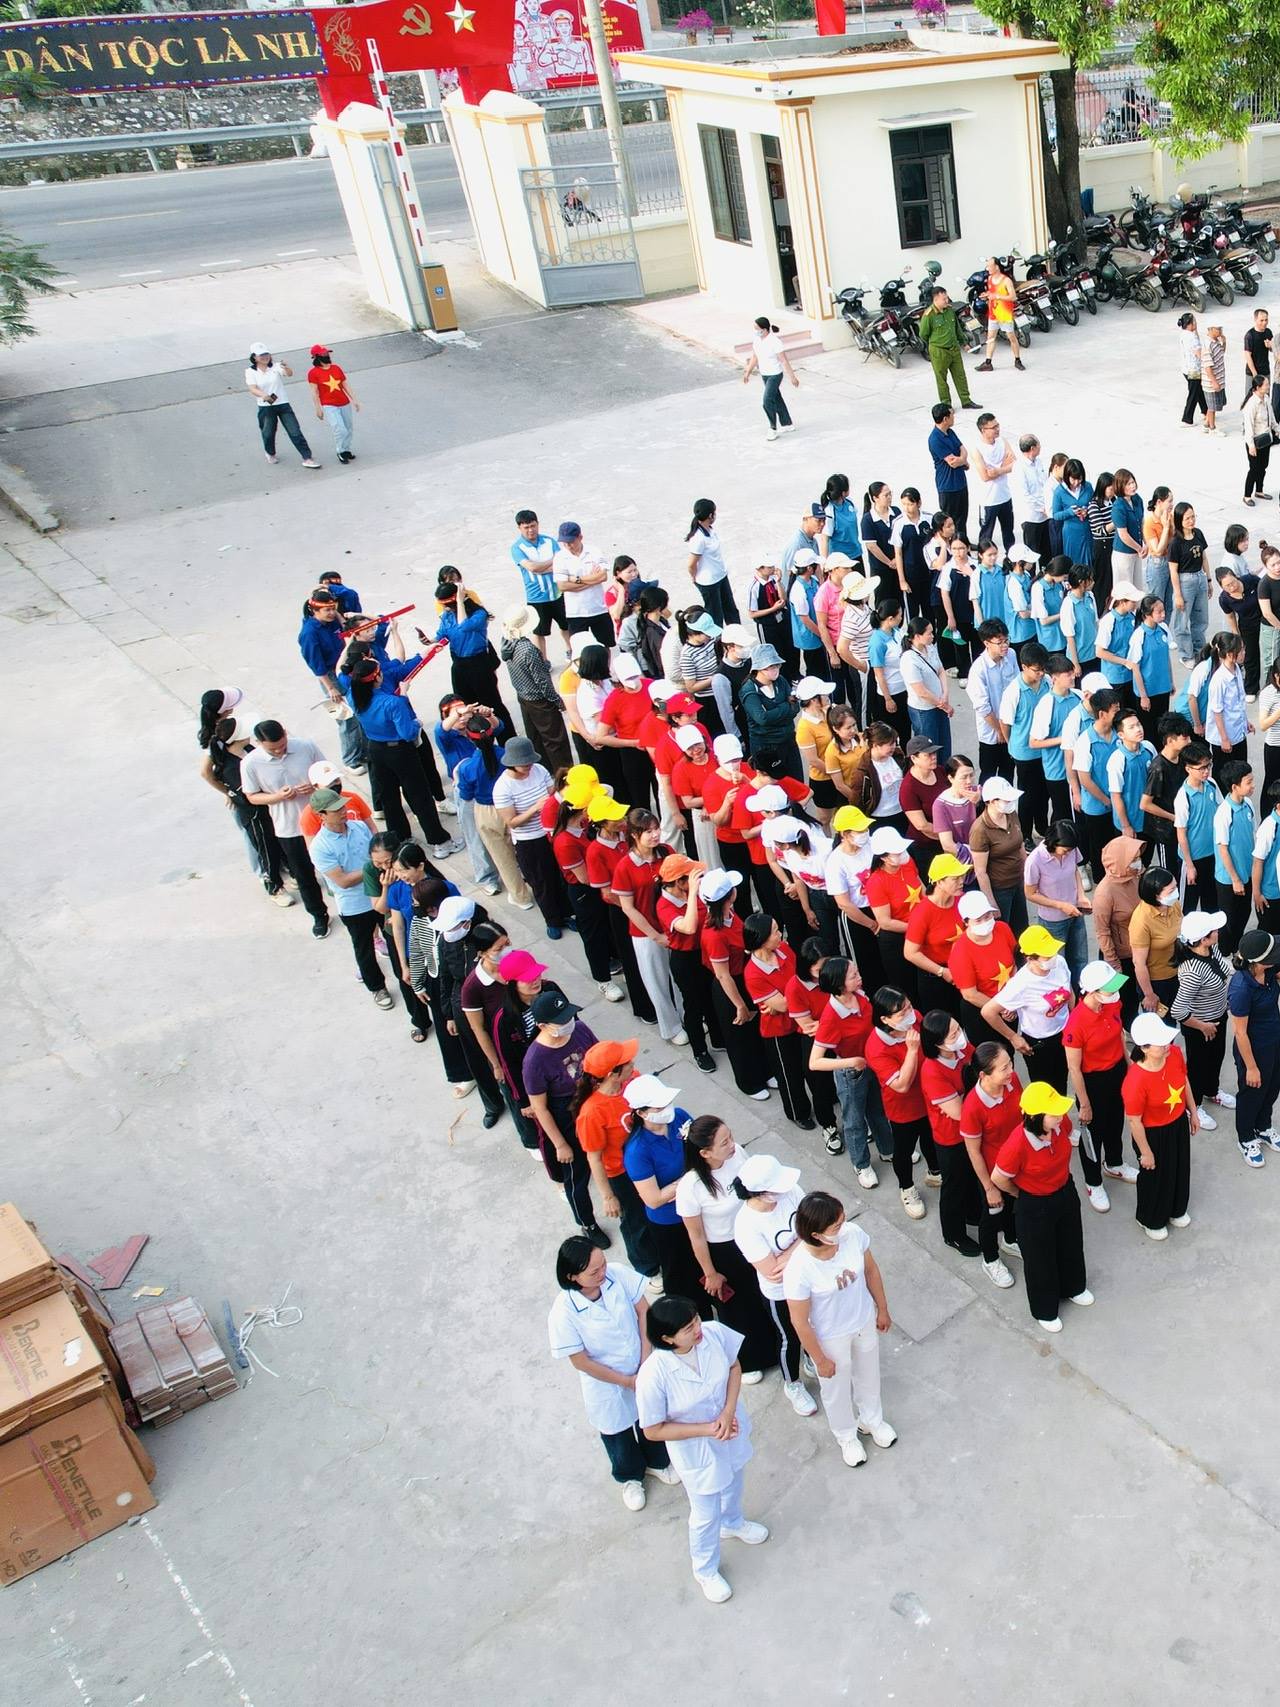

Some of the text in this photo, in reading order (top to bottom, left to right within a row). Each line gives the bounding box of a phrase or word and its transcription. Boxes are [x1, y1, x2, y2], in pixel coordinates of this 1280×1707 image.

[2, 36, 94, 73] DÂN
[98, 35, 189, 75] TỘC
[193, 27, 252, 64] LÀ
[50, 1434, 103, 1521] BENETILE
